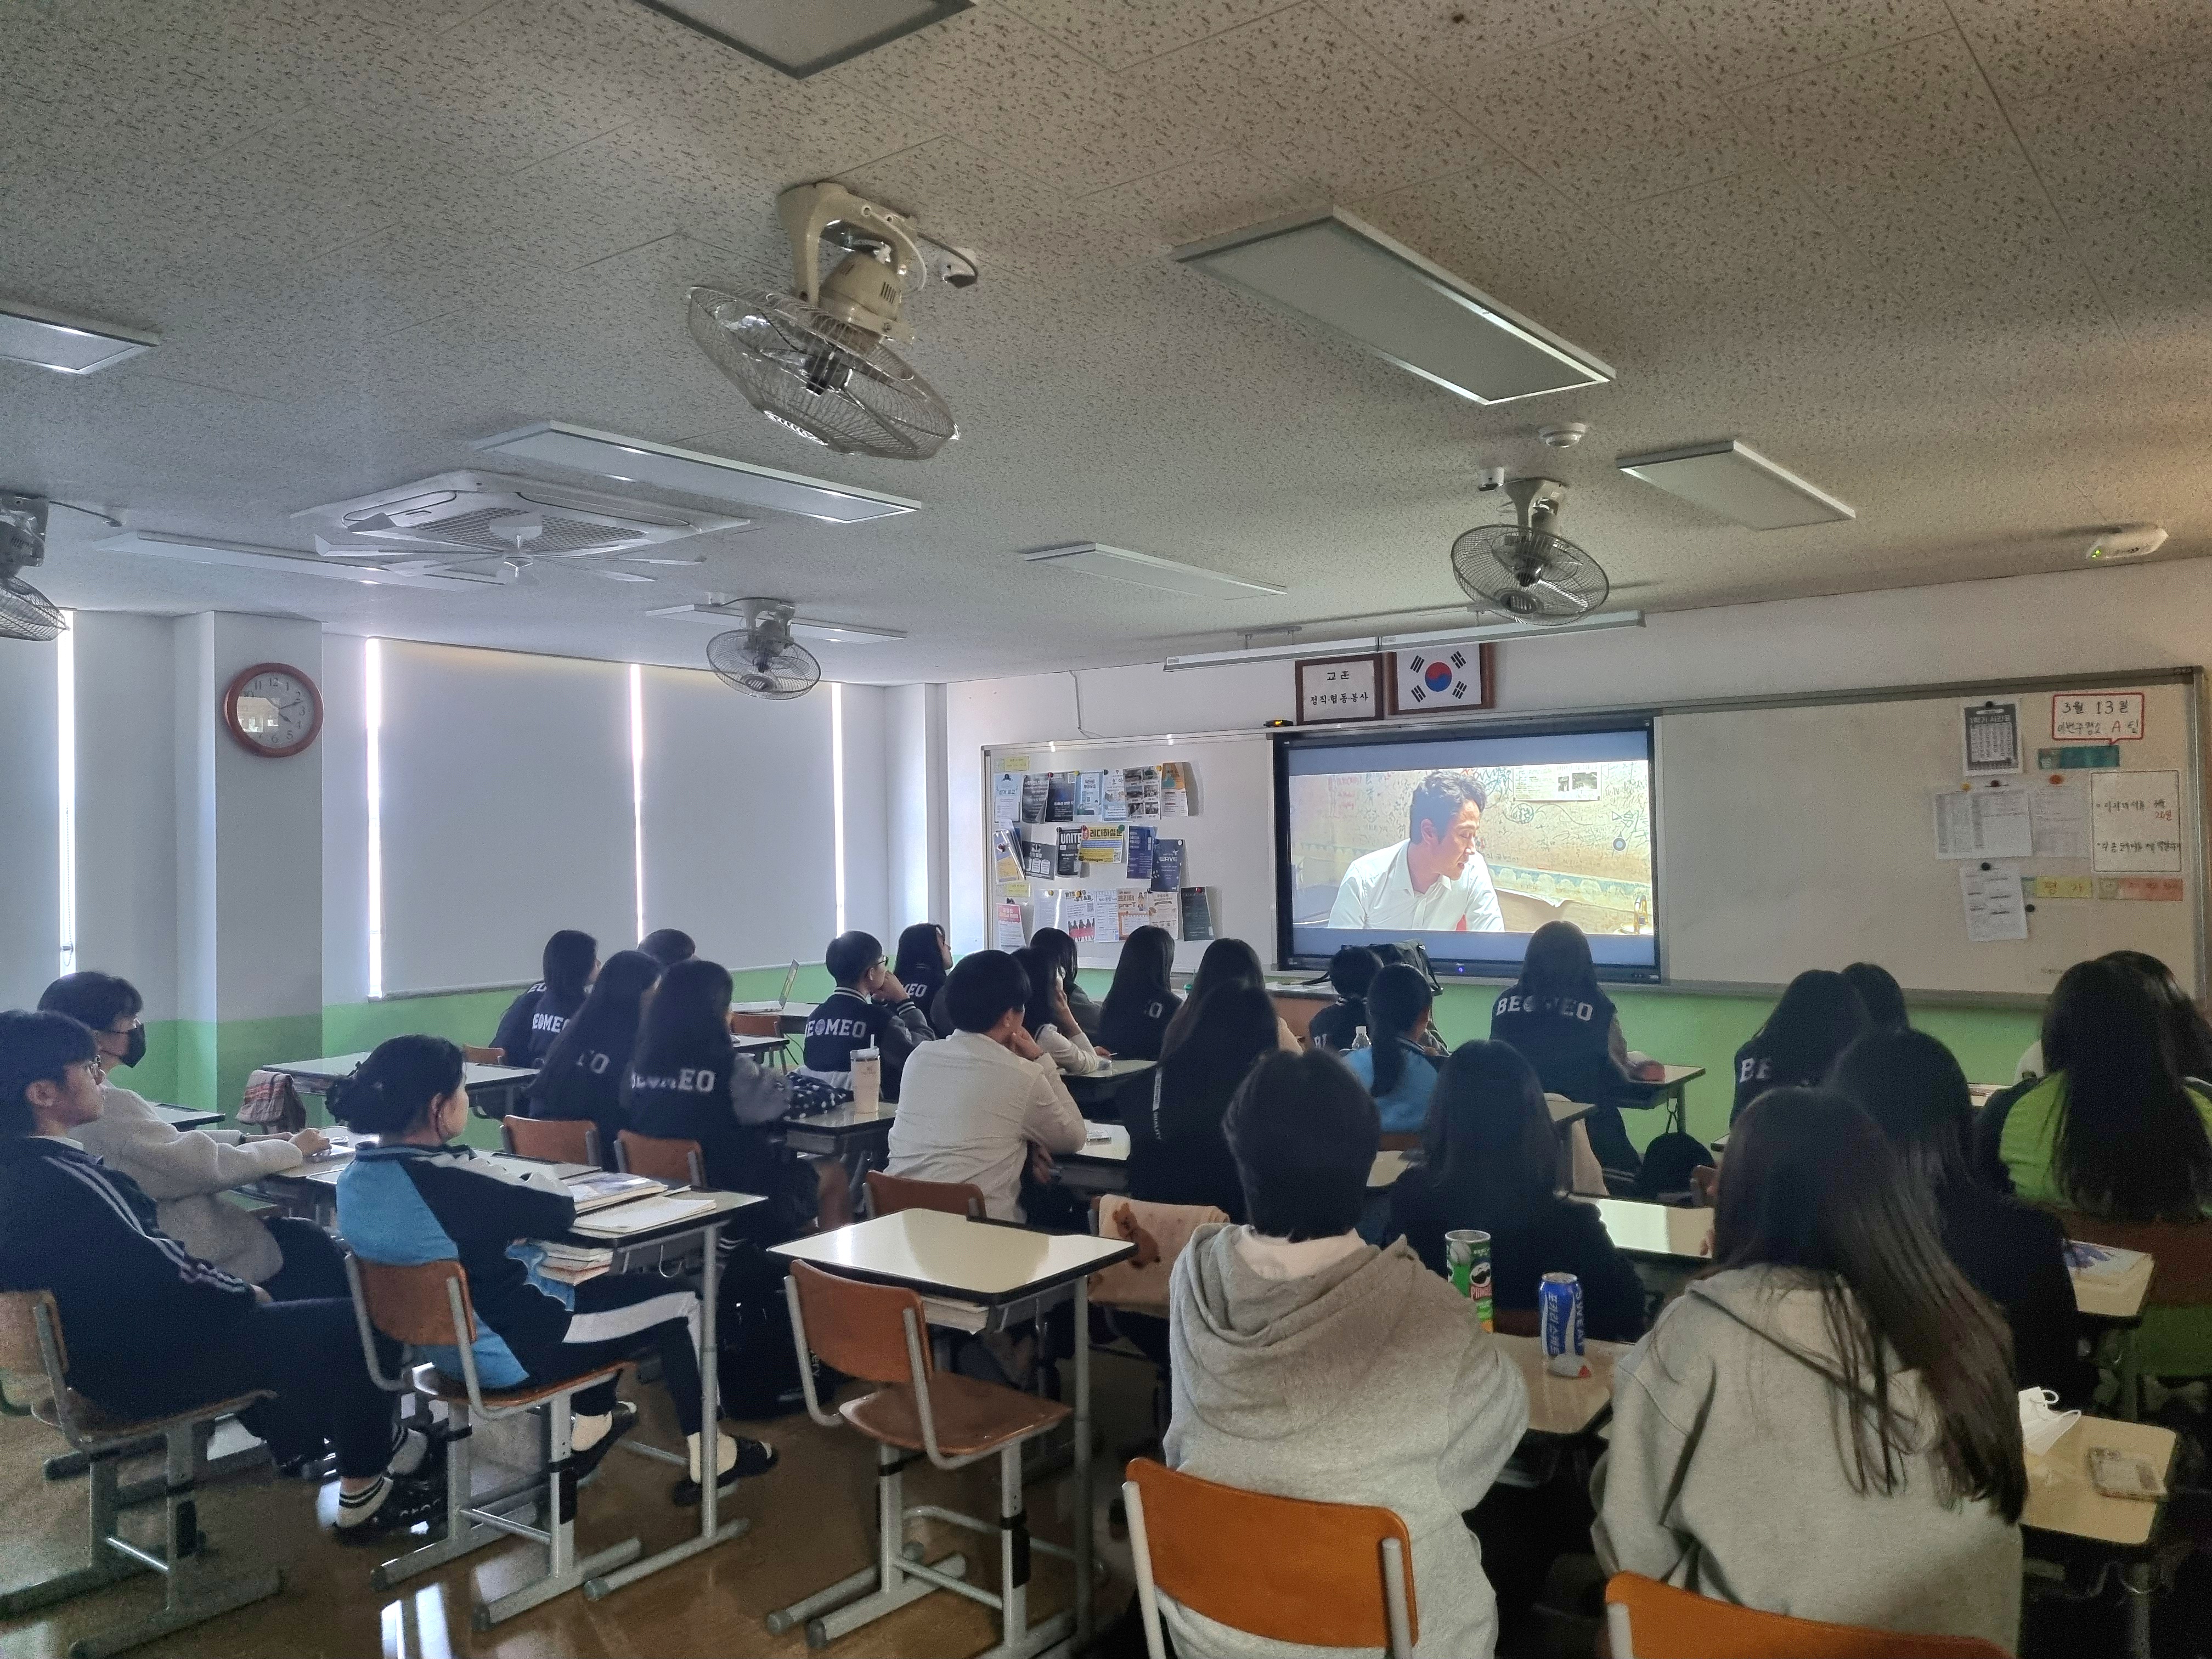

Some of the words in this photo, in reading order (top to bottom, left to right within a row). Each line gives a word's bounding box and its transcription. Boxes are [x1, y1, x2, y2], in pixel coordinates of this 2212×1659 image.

[1326, 670, 1350, 681] 교훈
[255, 680, 262, 690] 11
[269, 677, 278, 687] 12
[286, 682, 289, 691] 1
[2062, 700, 2084, 714] 3월
[2112, 720, 2121, 733] A
[805, 1018, 867, 1039] EOMEO
